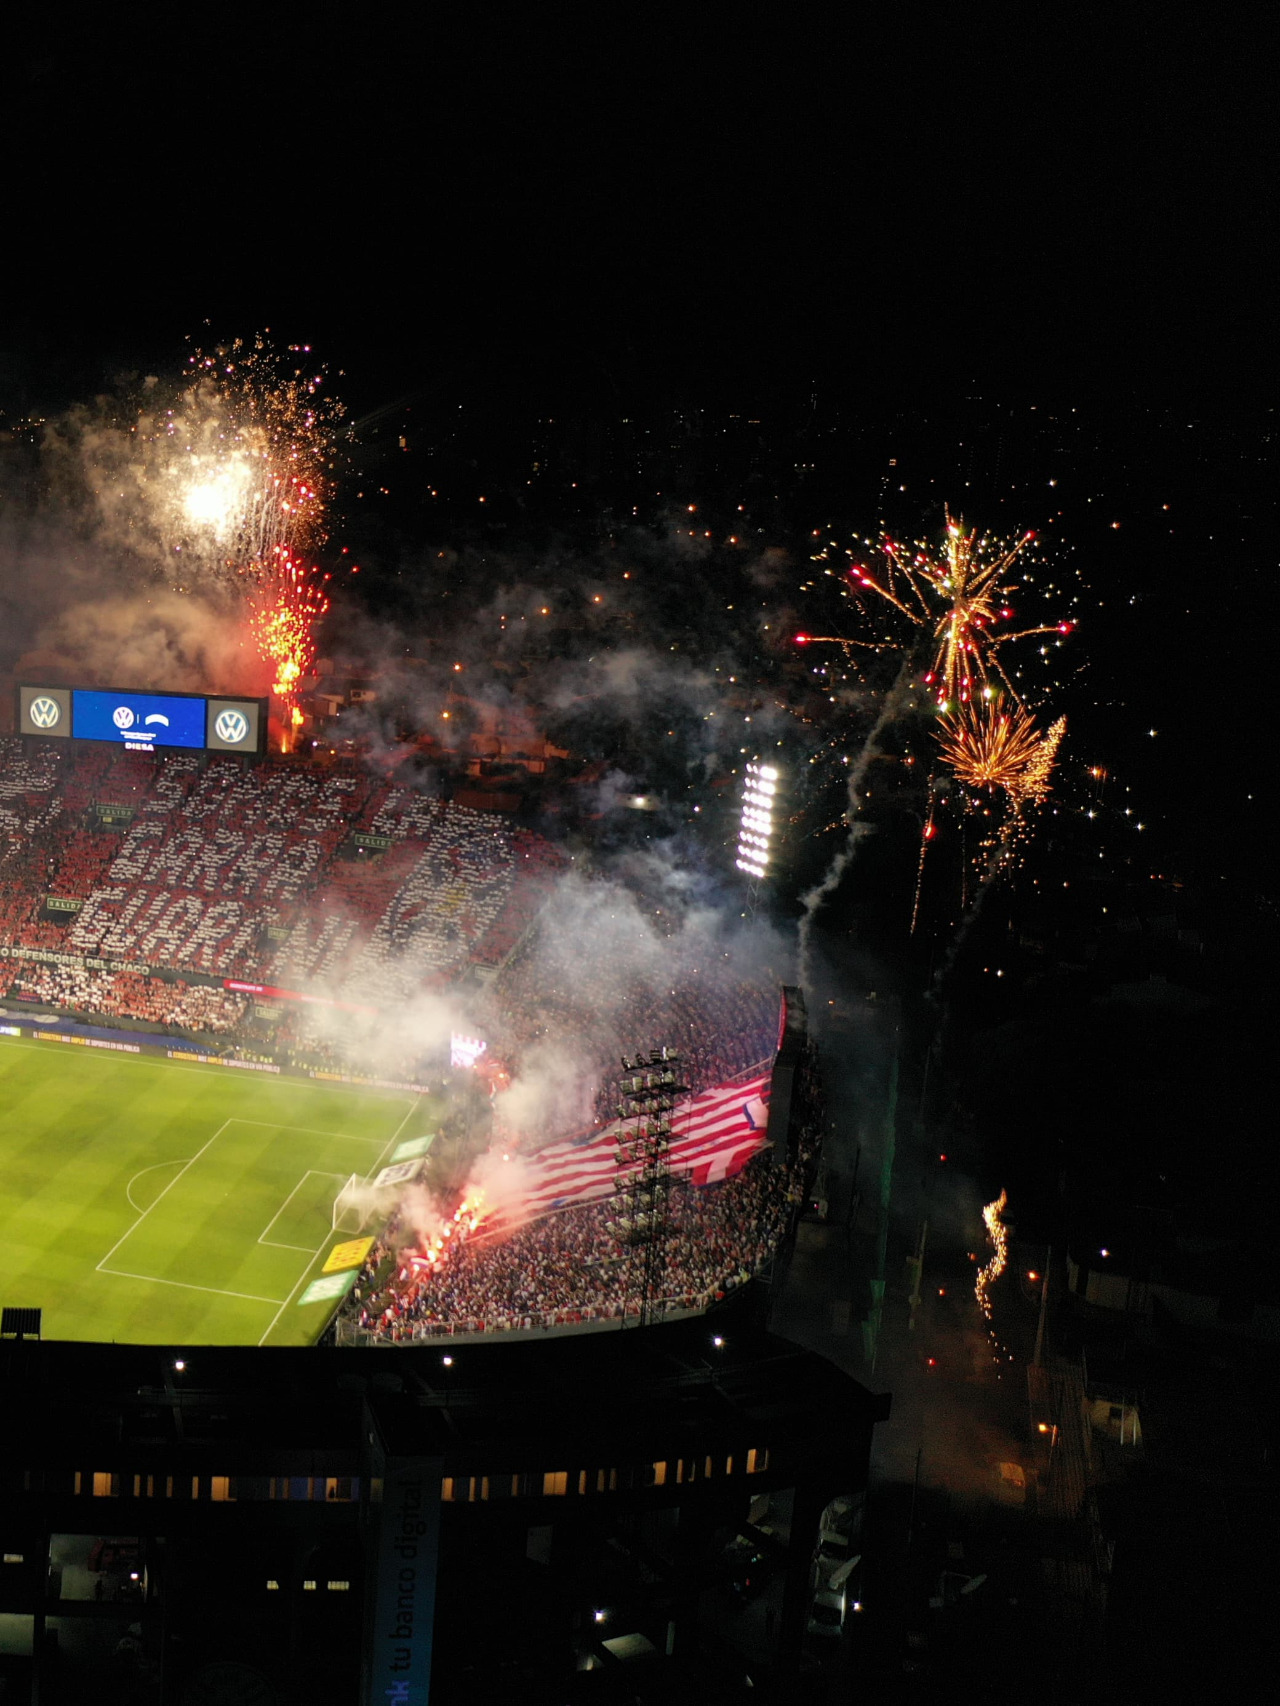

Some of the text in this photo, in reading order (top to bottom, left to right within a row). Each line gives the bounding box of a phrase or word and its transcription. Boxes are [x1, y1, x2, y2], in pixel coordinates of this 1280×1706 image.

[100, 808, 132, 817] SALIDA
[11, 948, 84, 966] DEFENSORES
[86, 958, 108, 969] DEL
[110, 962, 150, 975] CHACO
[394, 1478, 427, 1560] digital
[388, 1567, 416, 1640] banco
[388, 1647, 411, 1673] tu
